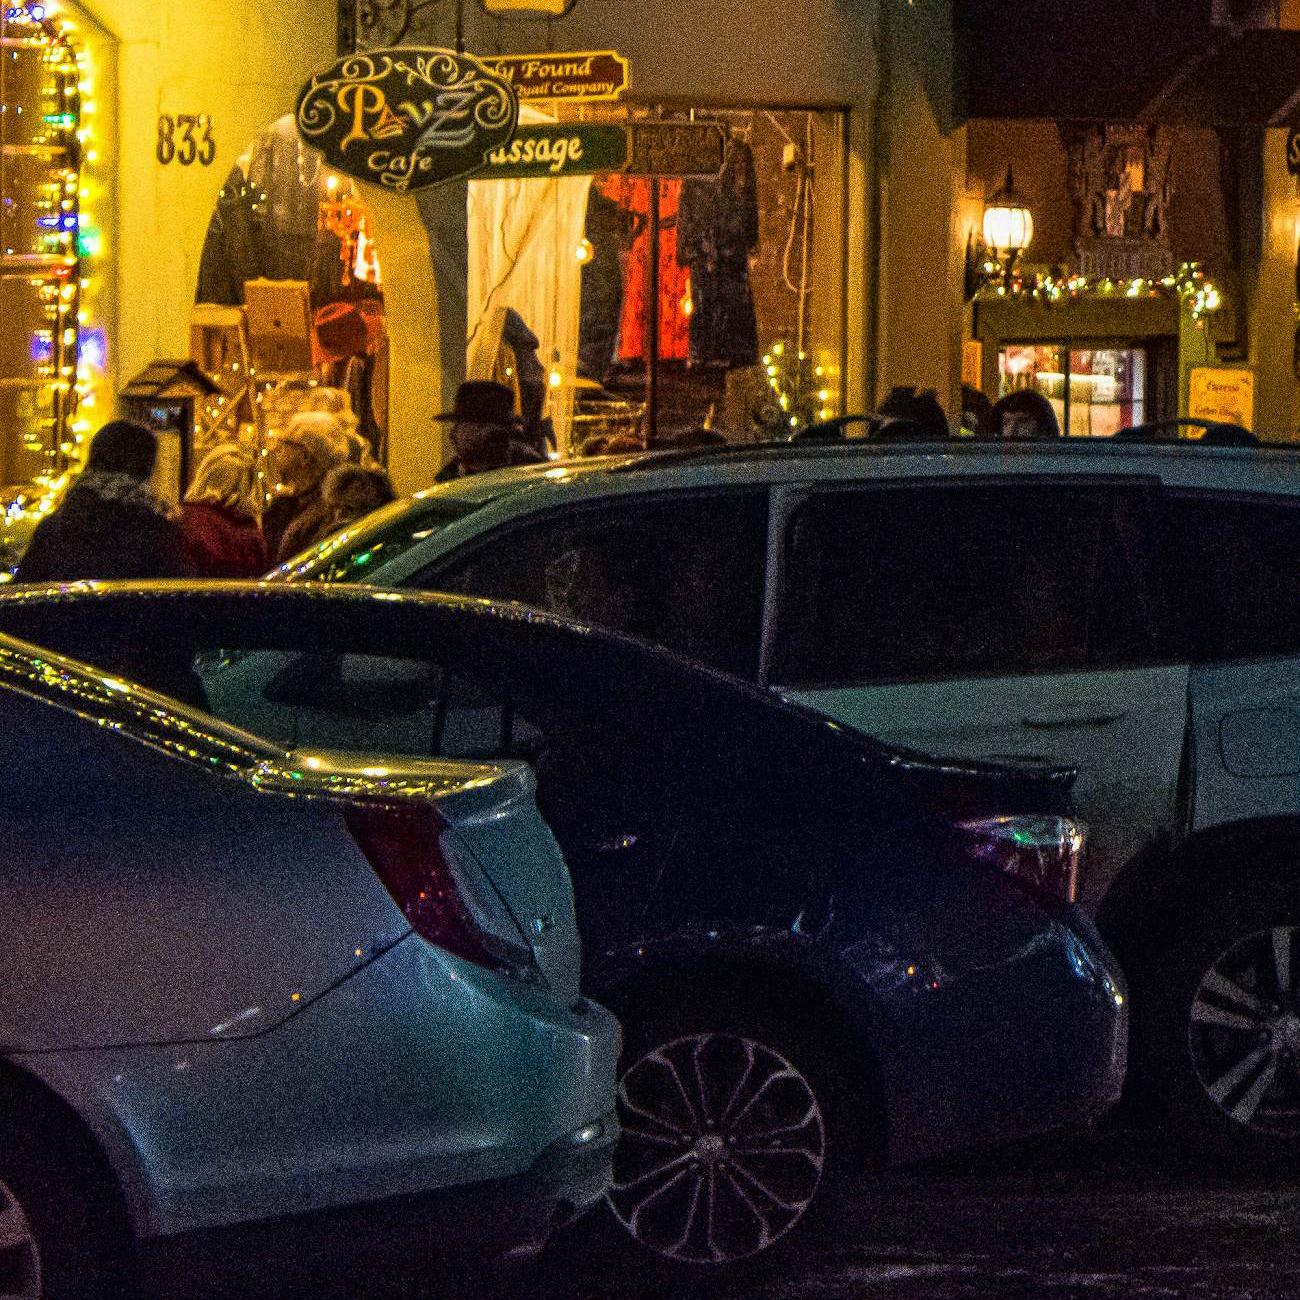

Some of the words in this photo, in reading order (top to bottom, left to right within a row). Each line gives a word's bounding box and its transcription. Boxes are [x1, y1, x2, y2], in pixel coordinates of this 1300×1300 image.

[522, 57, 595, 79] Found
[552, 81, 616, 98] Company
[156, 113, 216, 167] 833
[490, 136, 584, 172] assage
